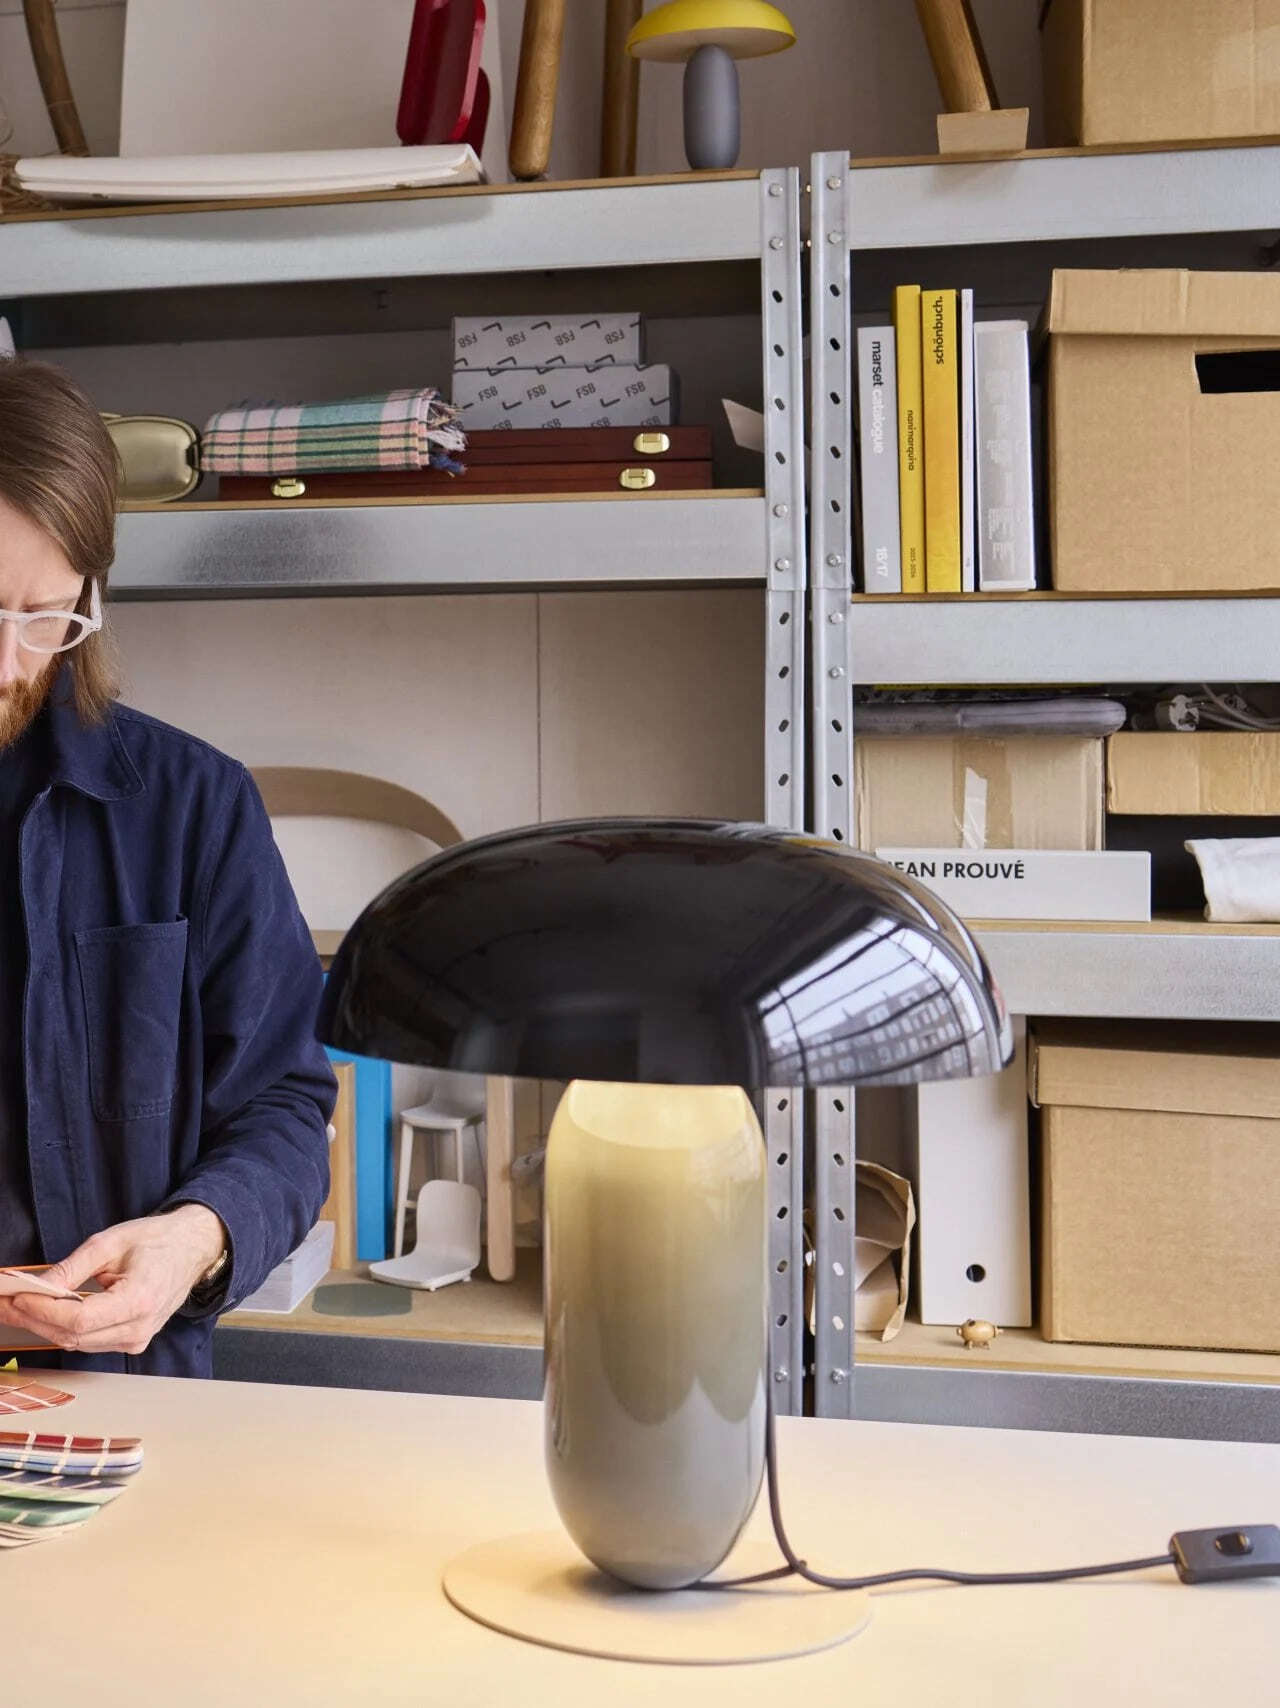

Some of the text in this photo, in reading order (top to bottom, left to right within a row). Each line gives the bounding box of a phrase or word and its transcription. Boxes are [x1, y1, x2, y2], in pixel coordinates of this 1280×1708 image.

[506, 331, 527, 347] FSB
[554, 330, 576, 346] FSB
[604, 329, 625, 345] FSB
[934, 296, 944, 365] schönbuch.
[457, 332, 478, 348] FSB
[872, 341, 884, 386] marset
[478, 385, 498, 402] FSB
[526, 384, 547, 401] FSB
[576, 382, 597, 399] FSB
[625, 381, 646, 398] FSB
[872, 388, 886, 454] catalogue
[906, 410, 916, 471] nanimarquina
[888, 859, 1025, 879] EAN PROUVÉ
